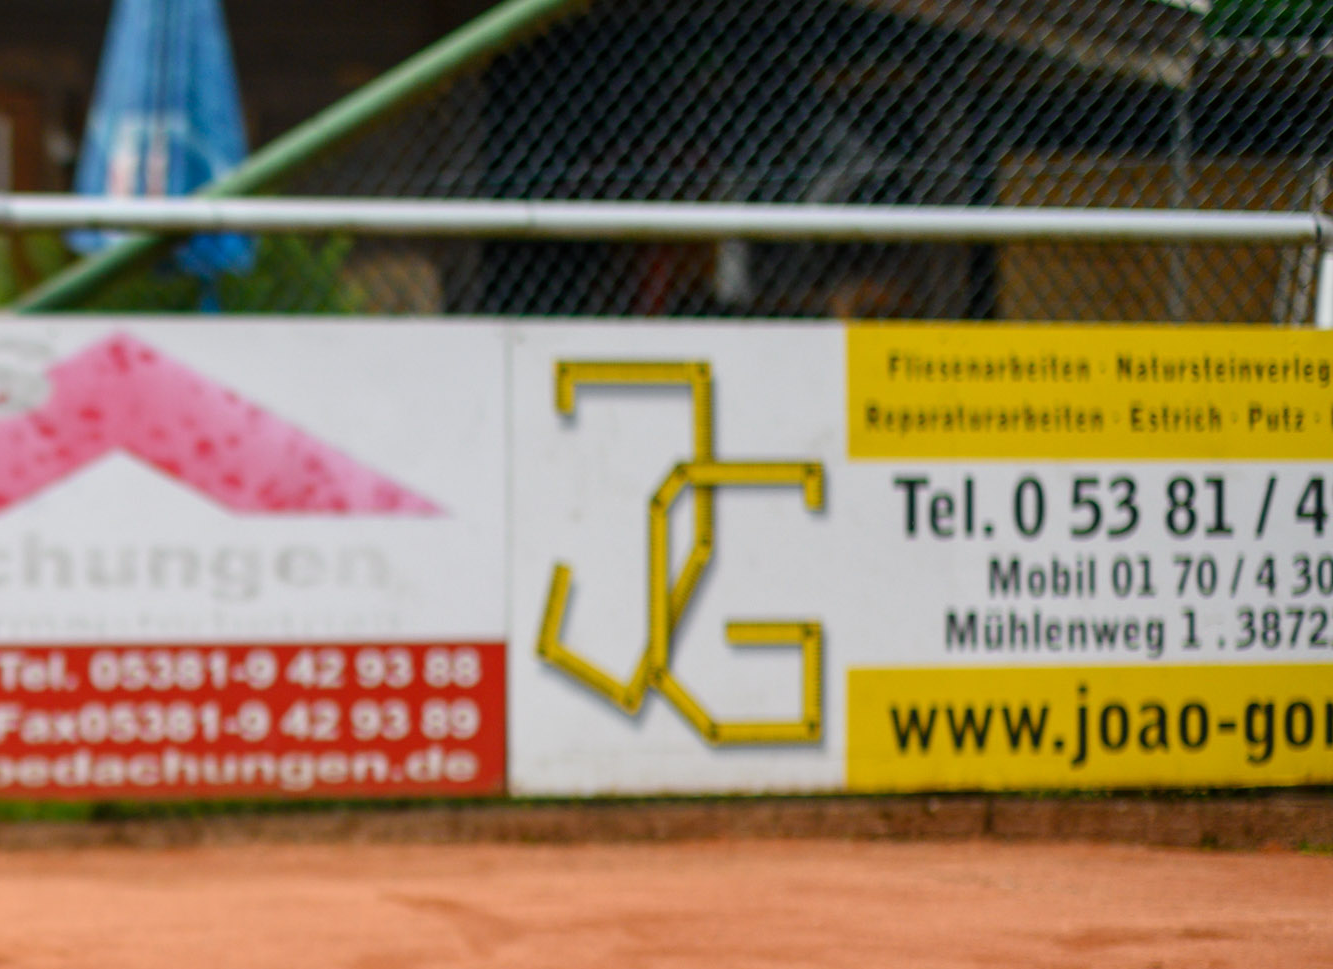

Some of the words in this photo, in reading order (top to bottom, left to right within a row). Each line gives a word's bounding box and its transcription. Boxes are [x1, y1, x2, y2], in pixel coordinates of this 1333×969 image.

[886, 350, 1092, 383] Fliesenarbeiten
[1115, 354, 1332, 389] Natursteinverleg
[863, 402, 1105, 435] Reparaturarbeiten
[1128, 403, 1223, 433] Estrich
[1246, 402, 1306, 432] Putz
[892, 476, 995, 538] Tel.
[1012, 475, 1047, 538] 0
[1070, 475, 1141, 539] 53
[1164, 475, 1234, 538] 81
[1254, 475, 1278, 538] /
[1294, 475, 1330, 537] 4
[987, 555, 1097, 598] Mobil
[1110, 555, 1155, 598] 01
[1173, 555, 1219, 597] 70
[1255, 555, 1278, 596] 4
[944, 609, 1166, 659] Mühlenweg
[1183, 607, 1200, 650] 1
[286, 648, 346, 690] 42
[354, 648, 415, 689] 93
[280, 700, 341, 742] 42
[349, 699, 411, 741] 93
